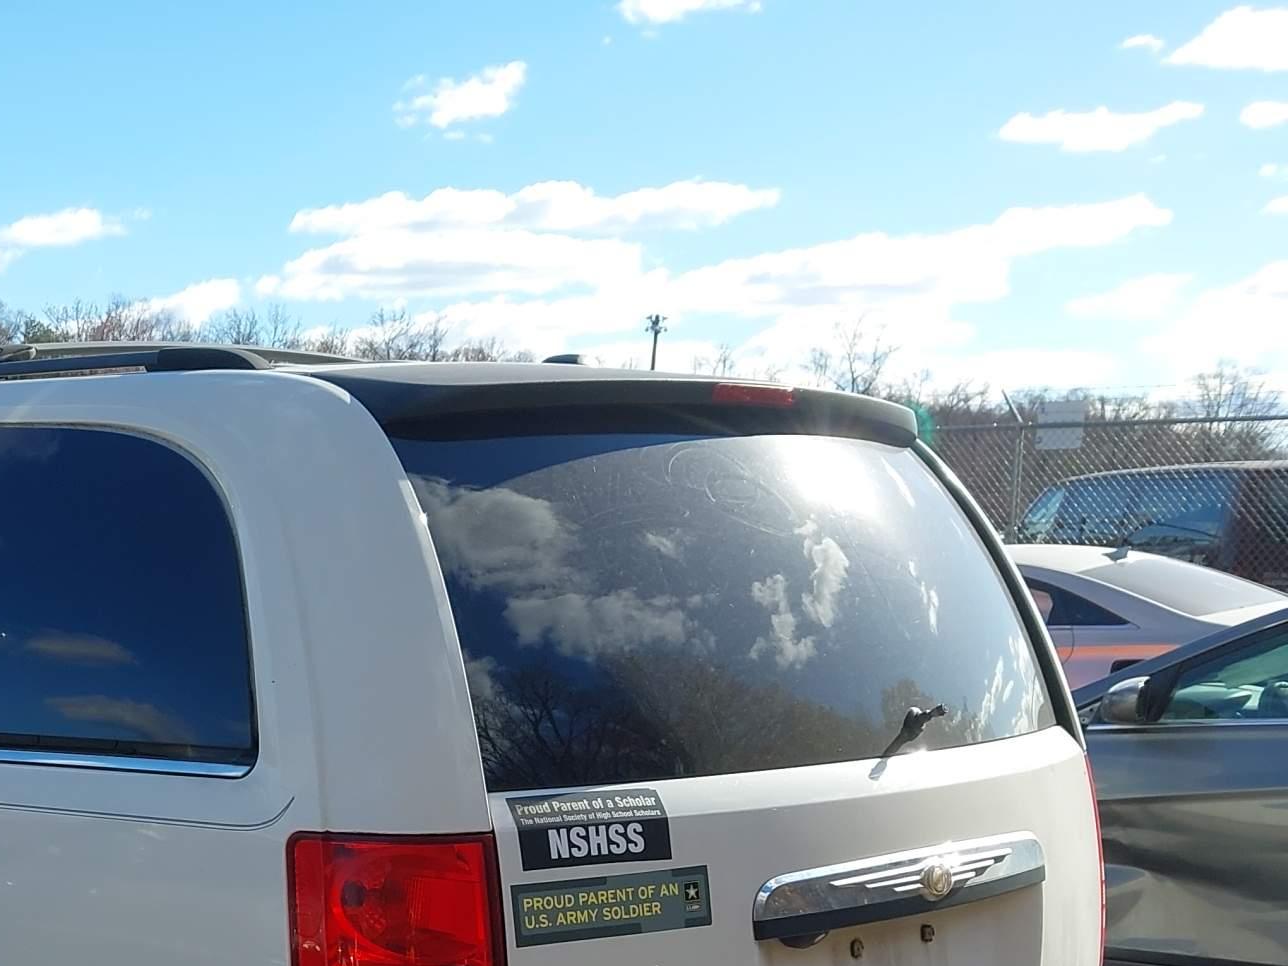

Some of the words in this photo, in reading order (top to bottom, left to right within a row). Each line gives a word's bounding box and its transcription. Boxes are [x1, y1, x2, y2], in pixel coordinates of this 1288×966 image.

[514, 801, 551, 815] Proud
[552, 799, 591, 812] Parent
[592, 797, 604, 809] of
[606, 799, 614, 808] a
[614, 795, 656, 808] Scholar
[534, 815, 562, 825] National
[563, 813, 587, 821] Society
[595, 811, 611, 820] High
[612, 810, 633, 818] School
[633, 809, 661, 817] Scholars
[547, 822, 645, 860] NSHSS
[523, 894, 575, 913] PROUD
[578, 887, 634, 906] PARENT
[638, 885, 656, 900] OF
[659, 882, 679, 897] AN
[524, 914, 552, 929] U.S.
[556, 908, 599, 926] ARMY
[602, 902, 662, 921] SOLDIER
